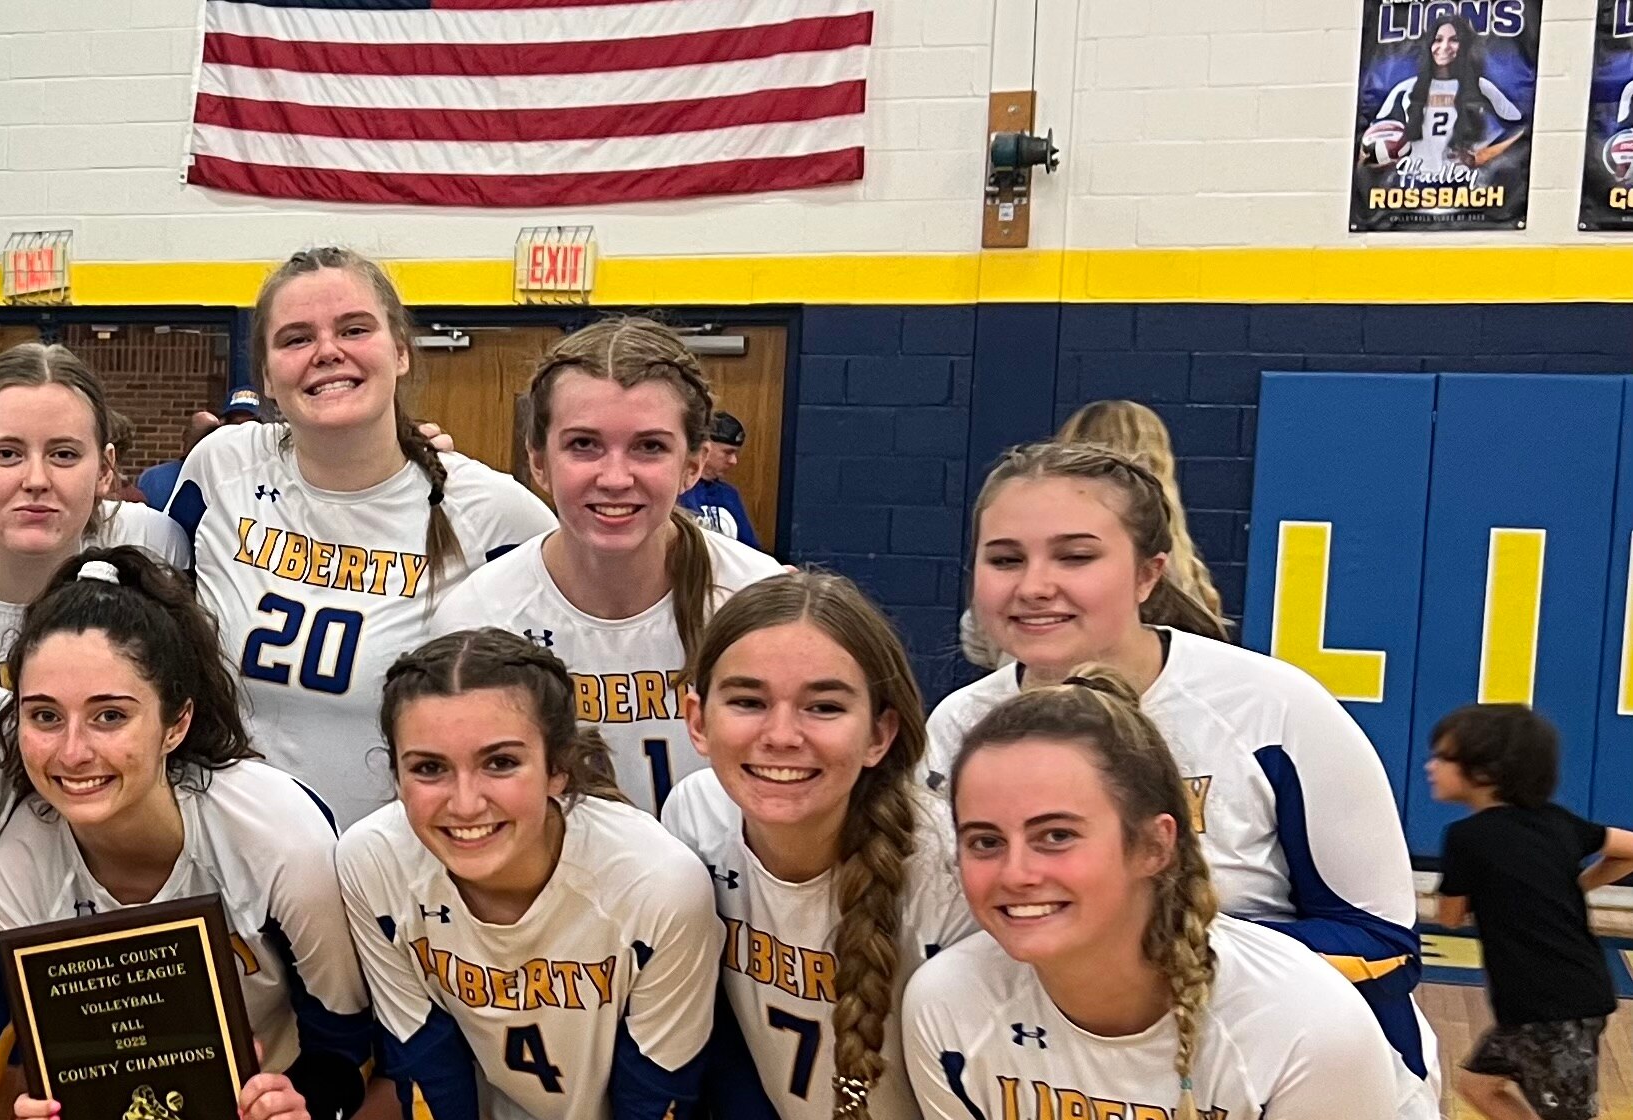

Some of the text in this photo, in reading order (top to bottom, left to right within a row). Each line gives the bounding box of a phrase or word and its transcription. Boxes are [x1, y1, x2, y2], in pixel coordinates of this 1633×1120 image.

[1432, 112, 1449, 136] 2
[1369, 186, 1504, 209] ROSSBACH
[530, 245, 582, 284] EXIT
[234, 517, 429, 598] LIBERTY
[240, 592, 364, 695] 20
[644, 739, 674, 823] 1
[48, 943, 179, 978] CARROLL COUNTY
[723, 917, 838, 1004] IBER
[50, 963, 187, 997] ATHLETIC LEAGUE
[80, 992, 165, 1016] VOLLEYBALL
[111, 1019, 144, 1034] FALL
[115, 1035, 148, 1050] 2022
[58, 1046, 216, 1084] COUNTY CHAMPIONS
[504, 1023, 565, 1093] 4
[767, 1005, 821, 1101] 7
